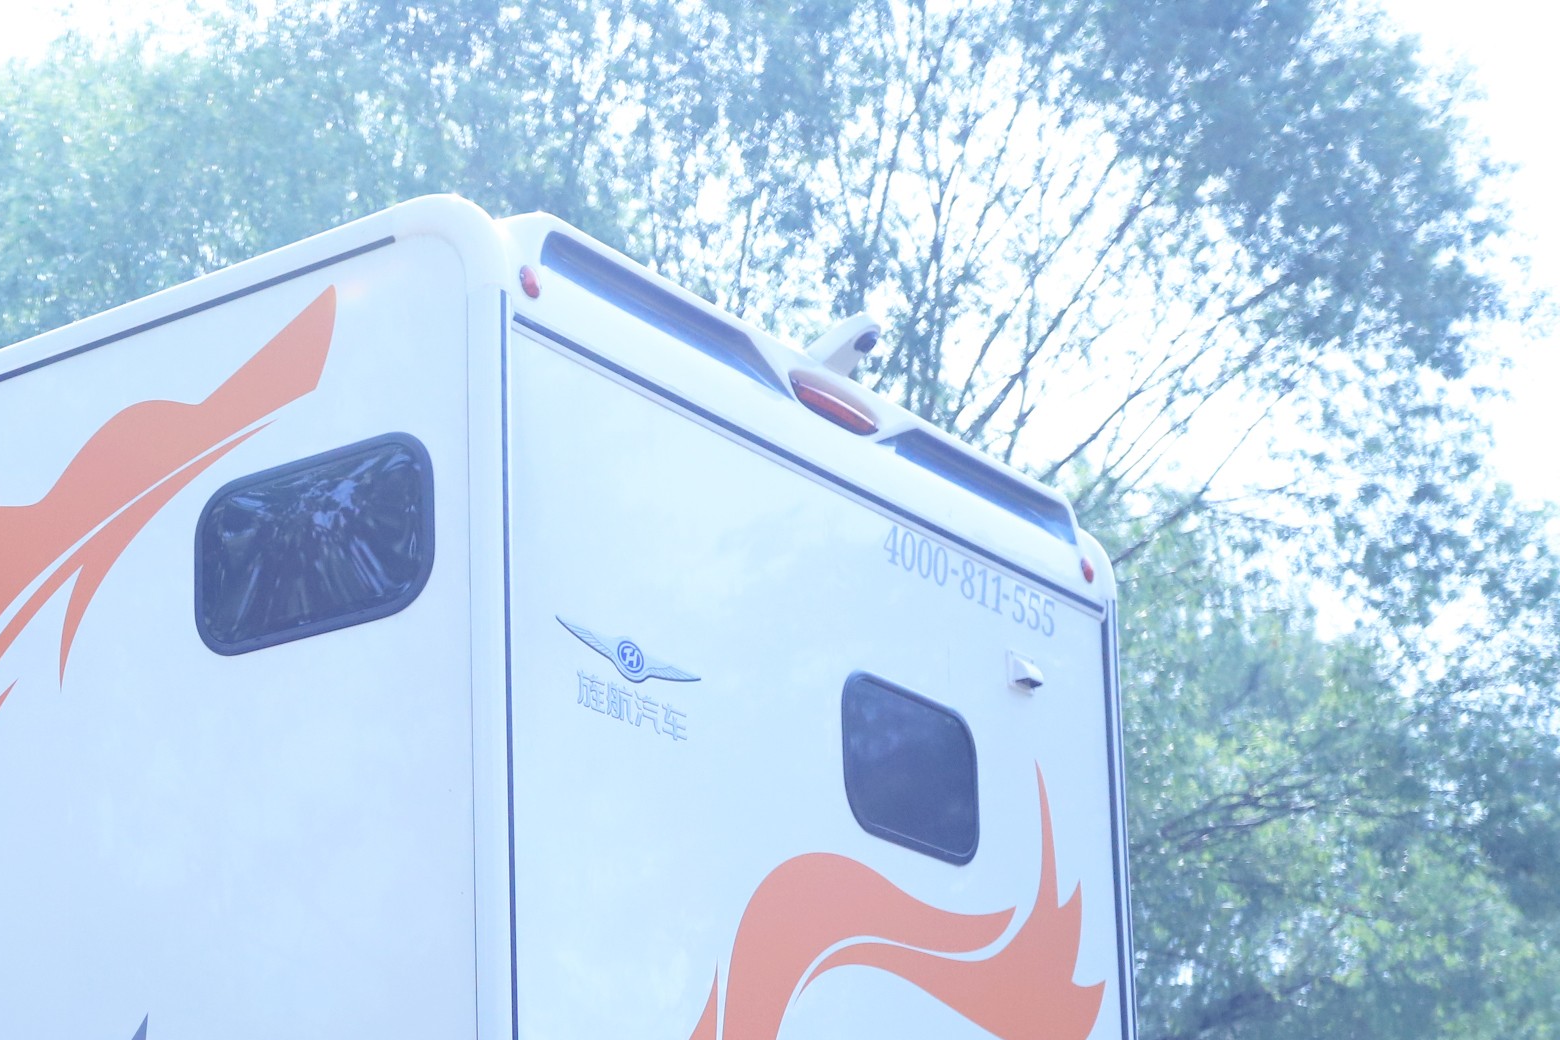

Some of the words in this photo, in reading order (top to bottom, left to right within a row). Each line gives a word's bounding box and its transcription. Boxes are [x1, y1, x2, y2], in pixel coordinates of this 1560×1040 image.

[883, 524, 1056, 638] 4000-811-555
[576, 669, 688, 741] 旌航汽车
